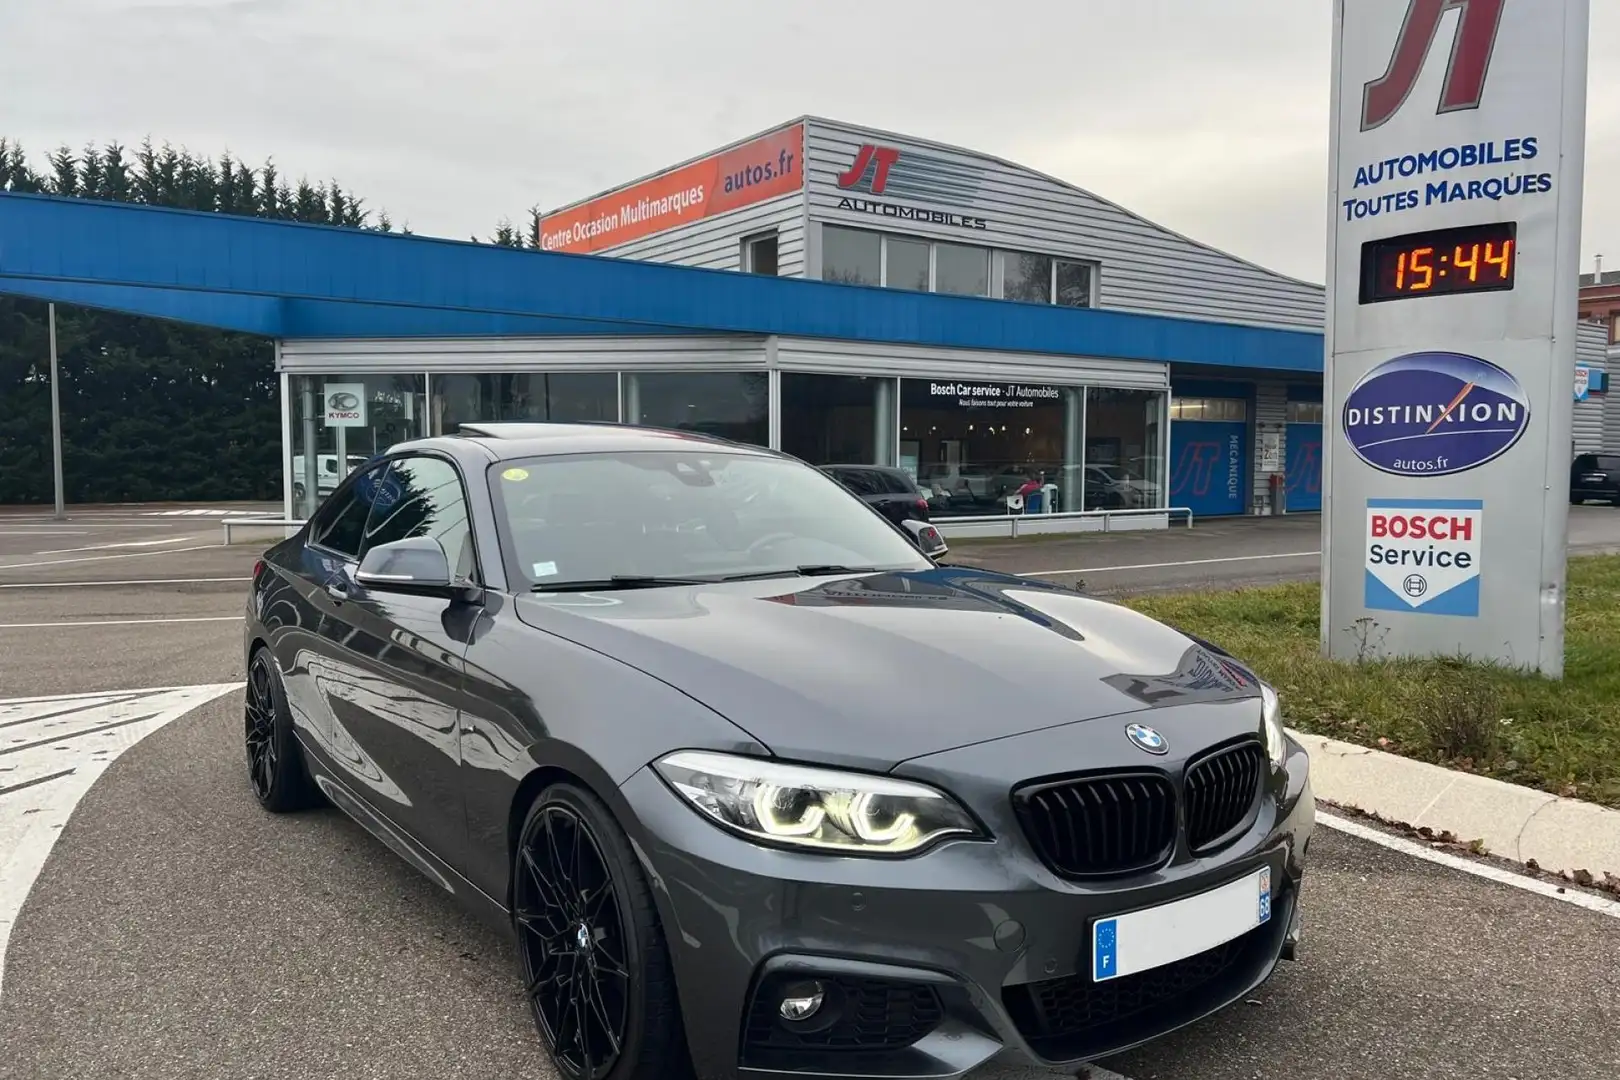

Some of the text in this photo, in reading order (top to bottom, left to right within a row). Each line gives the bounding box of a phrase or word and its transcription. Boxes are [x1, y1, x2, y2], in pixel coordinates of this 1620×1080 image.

[836, 145, 900, 195] JT
[1353, 136, 1537, 188] AUTOMOBILES
[541, 150, 794, 250] Centre Occasion Multimarques autos.fr
[1343, 173, 1552, 221] TOUTES MARQUES
[837, 197, 987, 230] AUTOMOBILES
[1395, 240, 1514, 290] 15:44
[930, 383, 956, 395] Bosch
[956, 384, 971, 396] Car
[972, 385, 1001, 397] service
[1006, 385, 1016, 397] JT
[1016, 386, 1059, 398] Automobiles
[1348, 402, 1517, 427] DISTINXION
[1228, 434, 1239, 499] MECANIQUE
[1393, 455, 1449, 472] autos.fr
[1371, 515, 1473, 541] BOSCH
[1369, 544, 1472, 569] Service
[1260, 897, 1270, 917] 68
[1103, 956, 1109, 968] F
